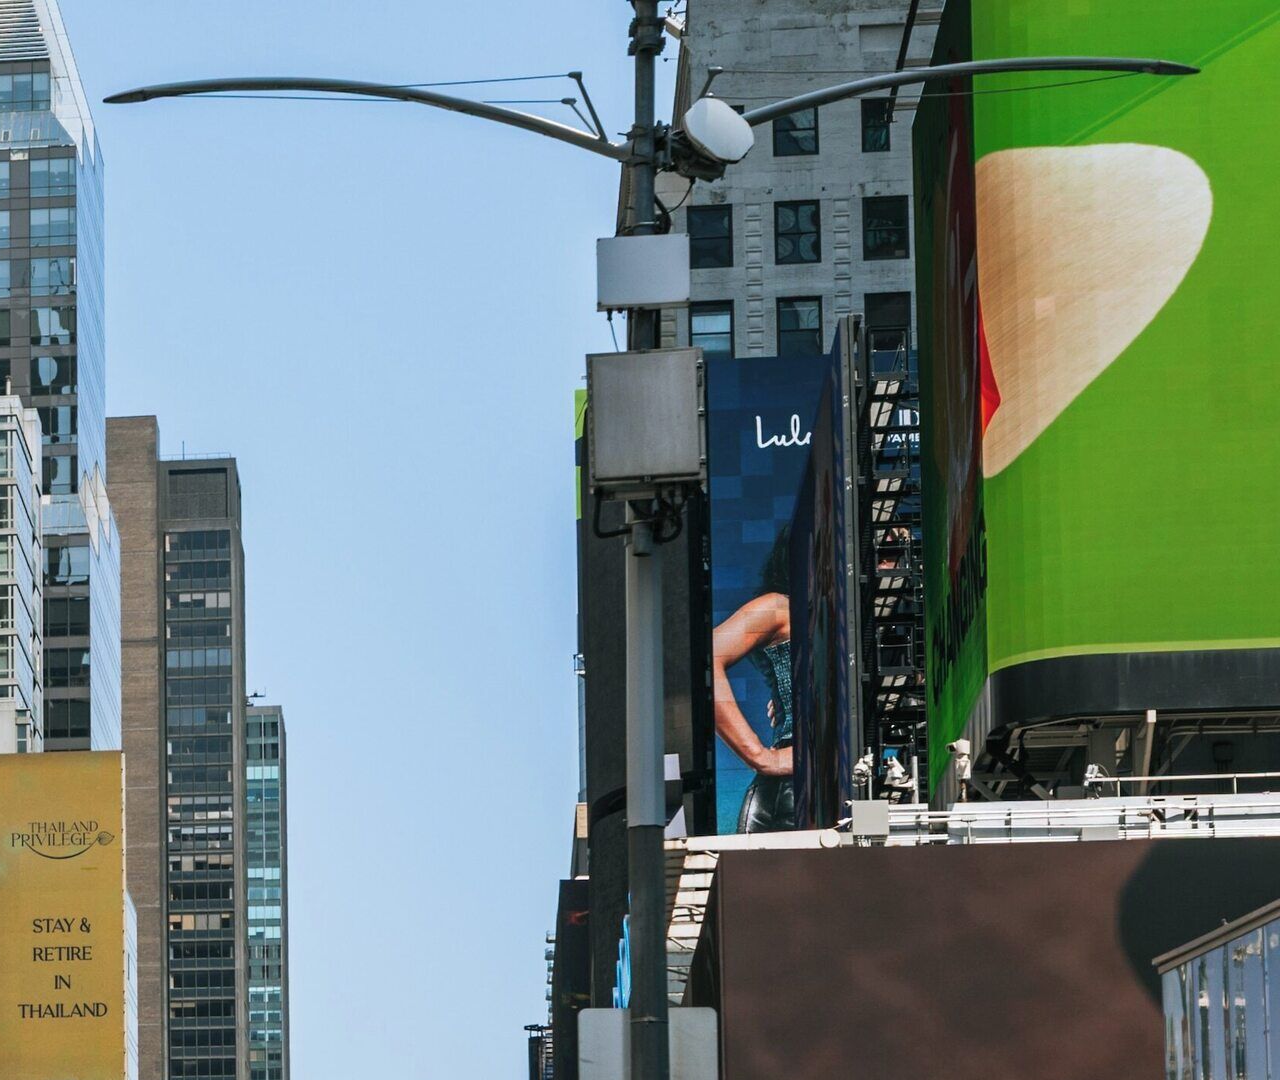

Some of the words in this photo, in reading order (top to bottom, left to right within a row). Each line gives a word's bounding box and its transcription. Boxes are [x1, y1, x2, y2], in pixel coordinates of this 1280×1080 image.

[28, 820, 99, 834] THAILAND
[11, 832, 92, 849] PRIVILEGE
[32, 918, 76, 934] STAY
[79, 917, 91, 934] &
[32, 945, 93, 962] RETIRE
[54, 974, 72, 990] IN
[17, 1002, 109, 1019] THAILAND
